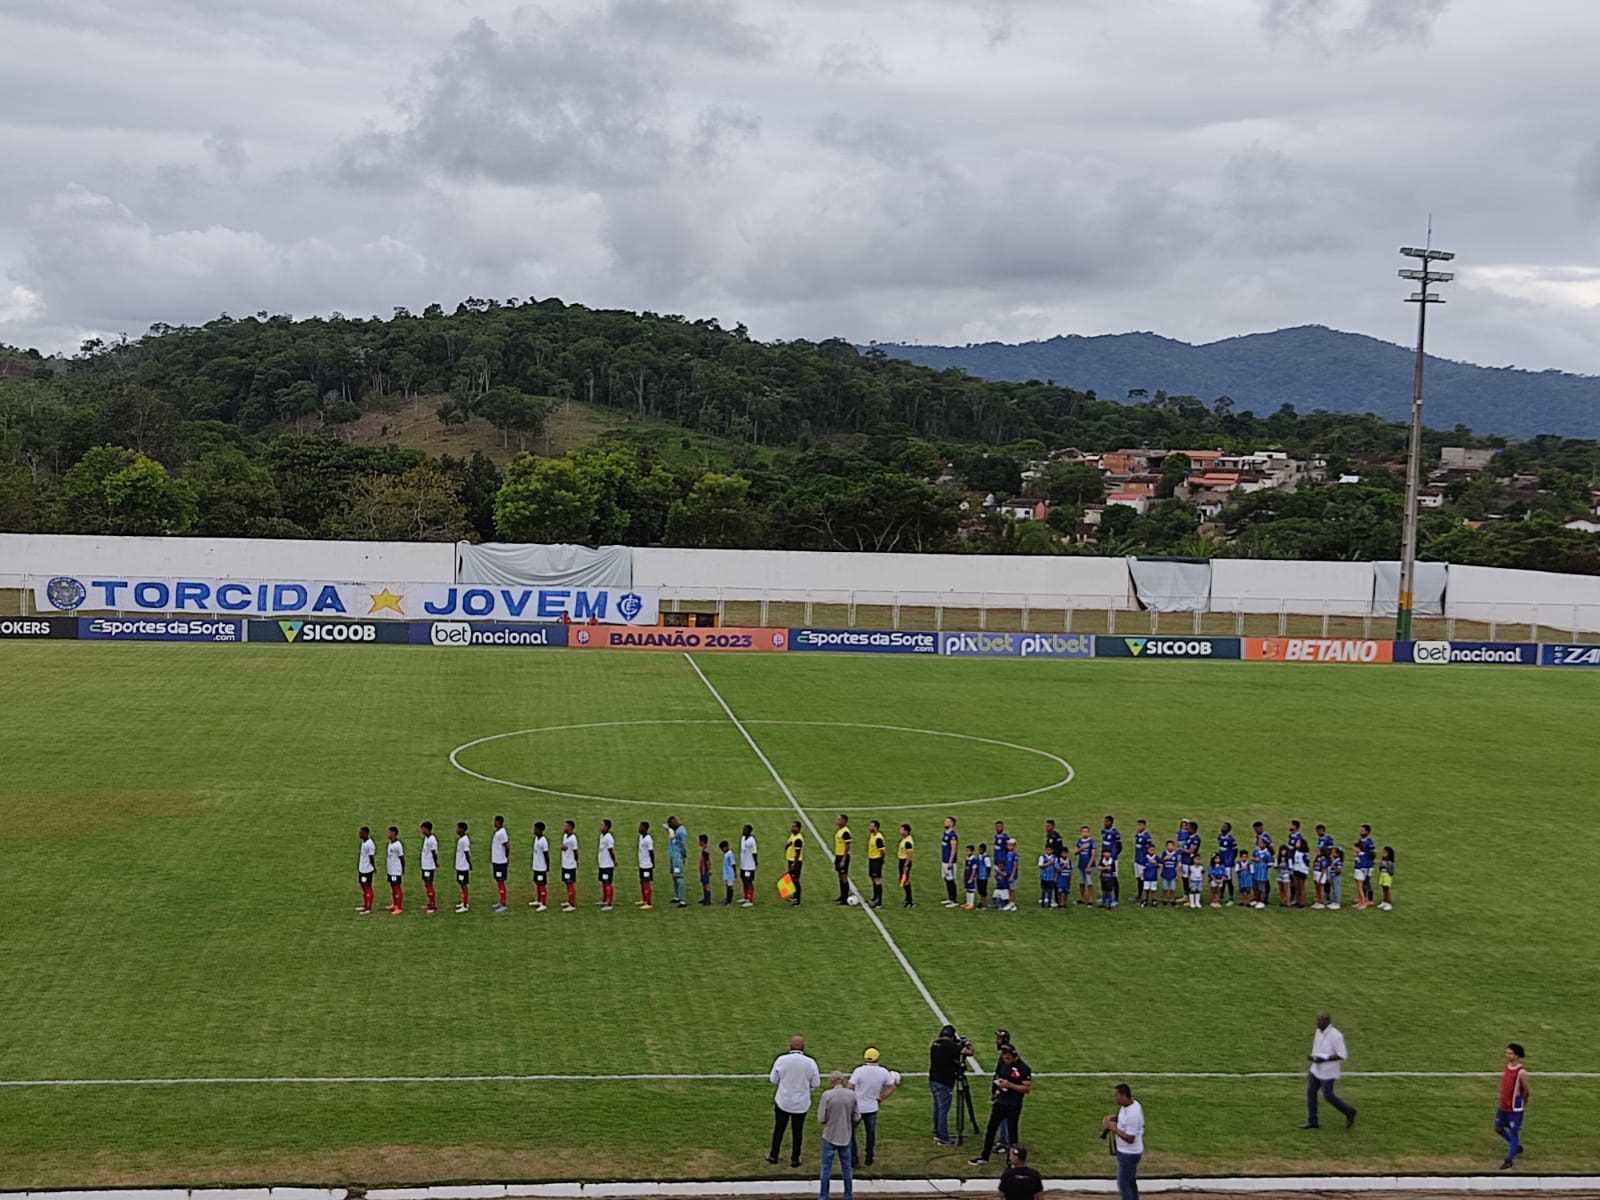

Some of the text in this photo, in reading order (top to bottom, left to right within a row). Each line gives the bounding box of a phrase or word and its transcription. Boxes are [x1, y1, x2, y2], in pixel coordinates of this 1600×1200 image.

[92, 581, 346, 613] TORCIDA
[424, 588, 608, 619] JOVEM
[303, 623, 375, 641] SICOOB
[610, 631, 752, 648] BAIANÃO 2023
[946, 633, 1088, 656] pixbet pixbet
[1146, 640, 1212, 655] SICOOB
[1285, 640, 1377, 662] BETANO
